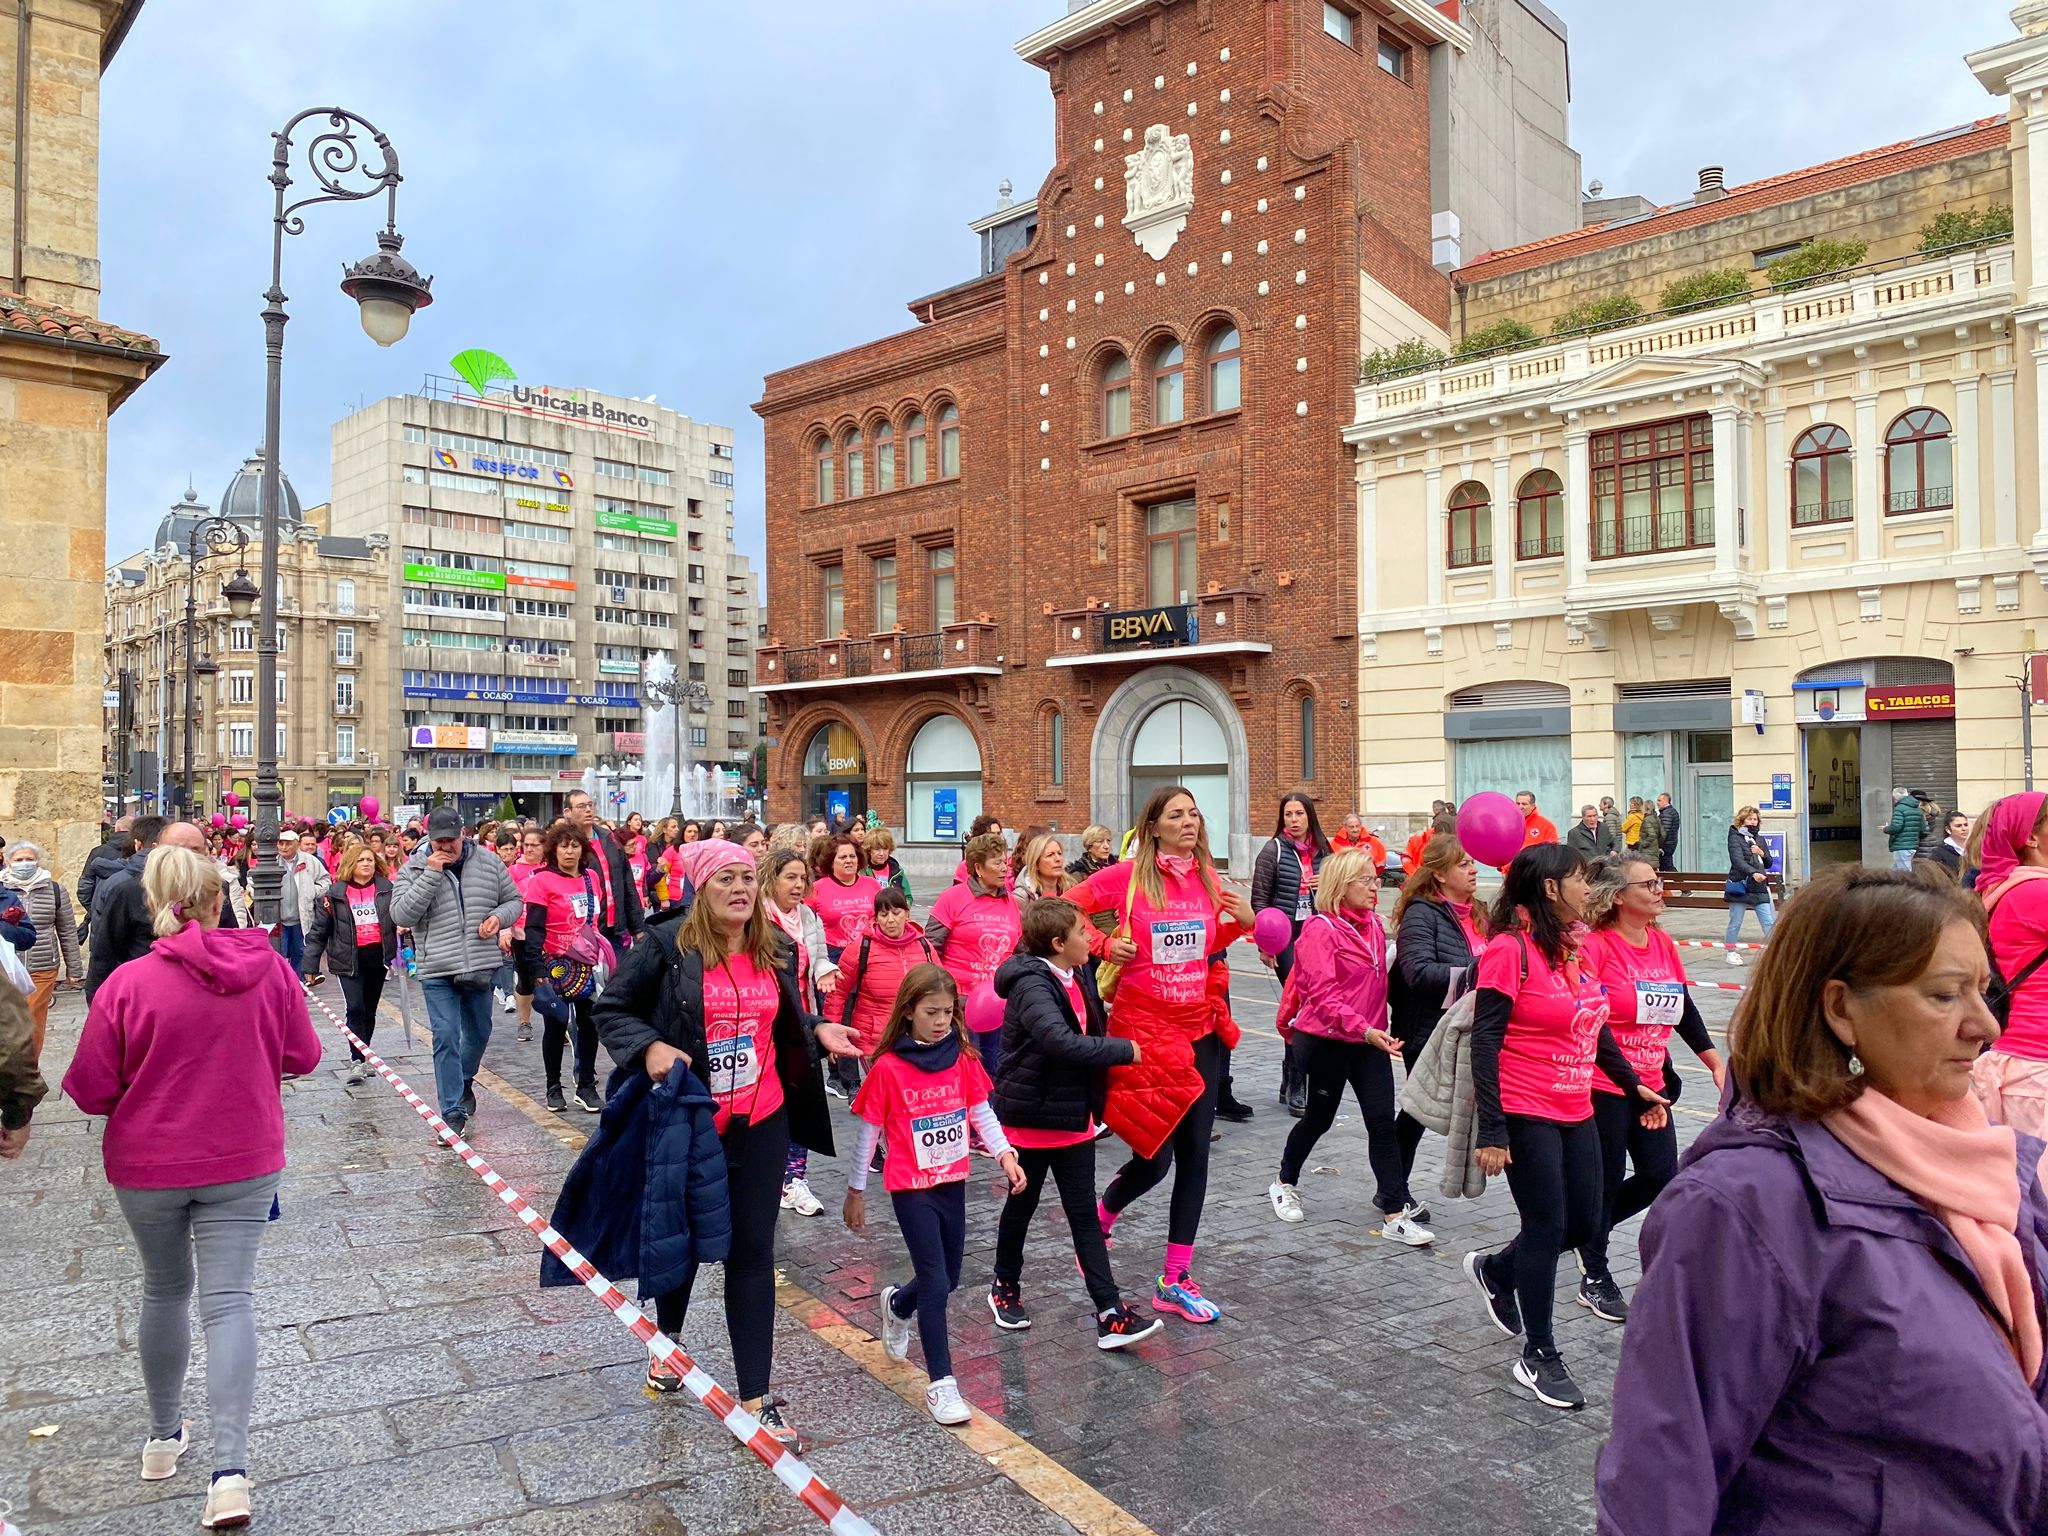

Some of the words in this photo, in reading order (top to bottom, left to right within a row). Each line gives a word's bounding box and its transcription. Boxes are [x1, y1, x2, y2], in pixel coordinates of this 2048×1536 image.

[513, 385, 589, 417] Unicaja
[592, 401, 649, 427] Banco
[472, 457, 538, 479] INSEFOR
[1110, 611, 1174, 640] BBVA
[482, 691, 513, 700] OCASO
[580, 696, 609, 705] OCASO
[1887, 695, 1950, 706] TABACOS
[829, 757, 857, 770] BBVA
[1163, 932, 1196, 947] 0811
[1165, 970, 1206, 983] CARRERA
[702, 979, 769, 999] Drasanvi
[1160, 983, 1199, 1002] Mujer
[1645, 993, 1678, 1008] 0777
[707, 1042, 747, 1055] solitium
[709, 1052, 749, 1073] 809
[903, 1077, 960, 1105] Drasanvi
[922, 1124, 963, 1147] 0808
